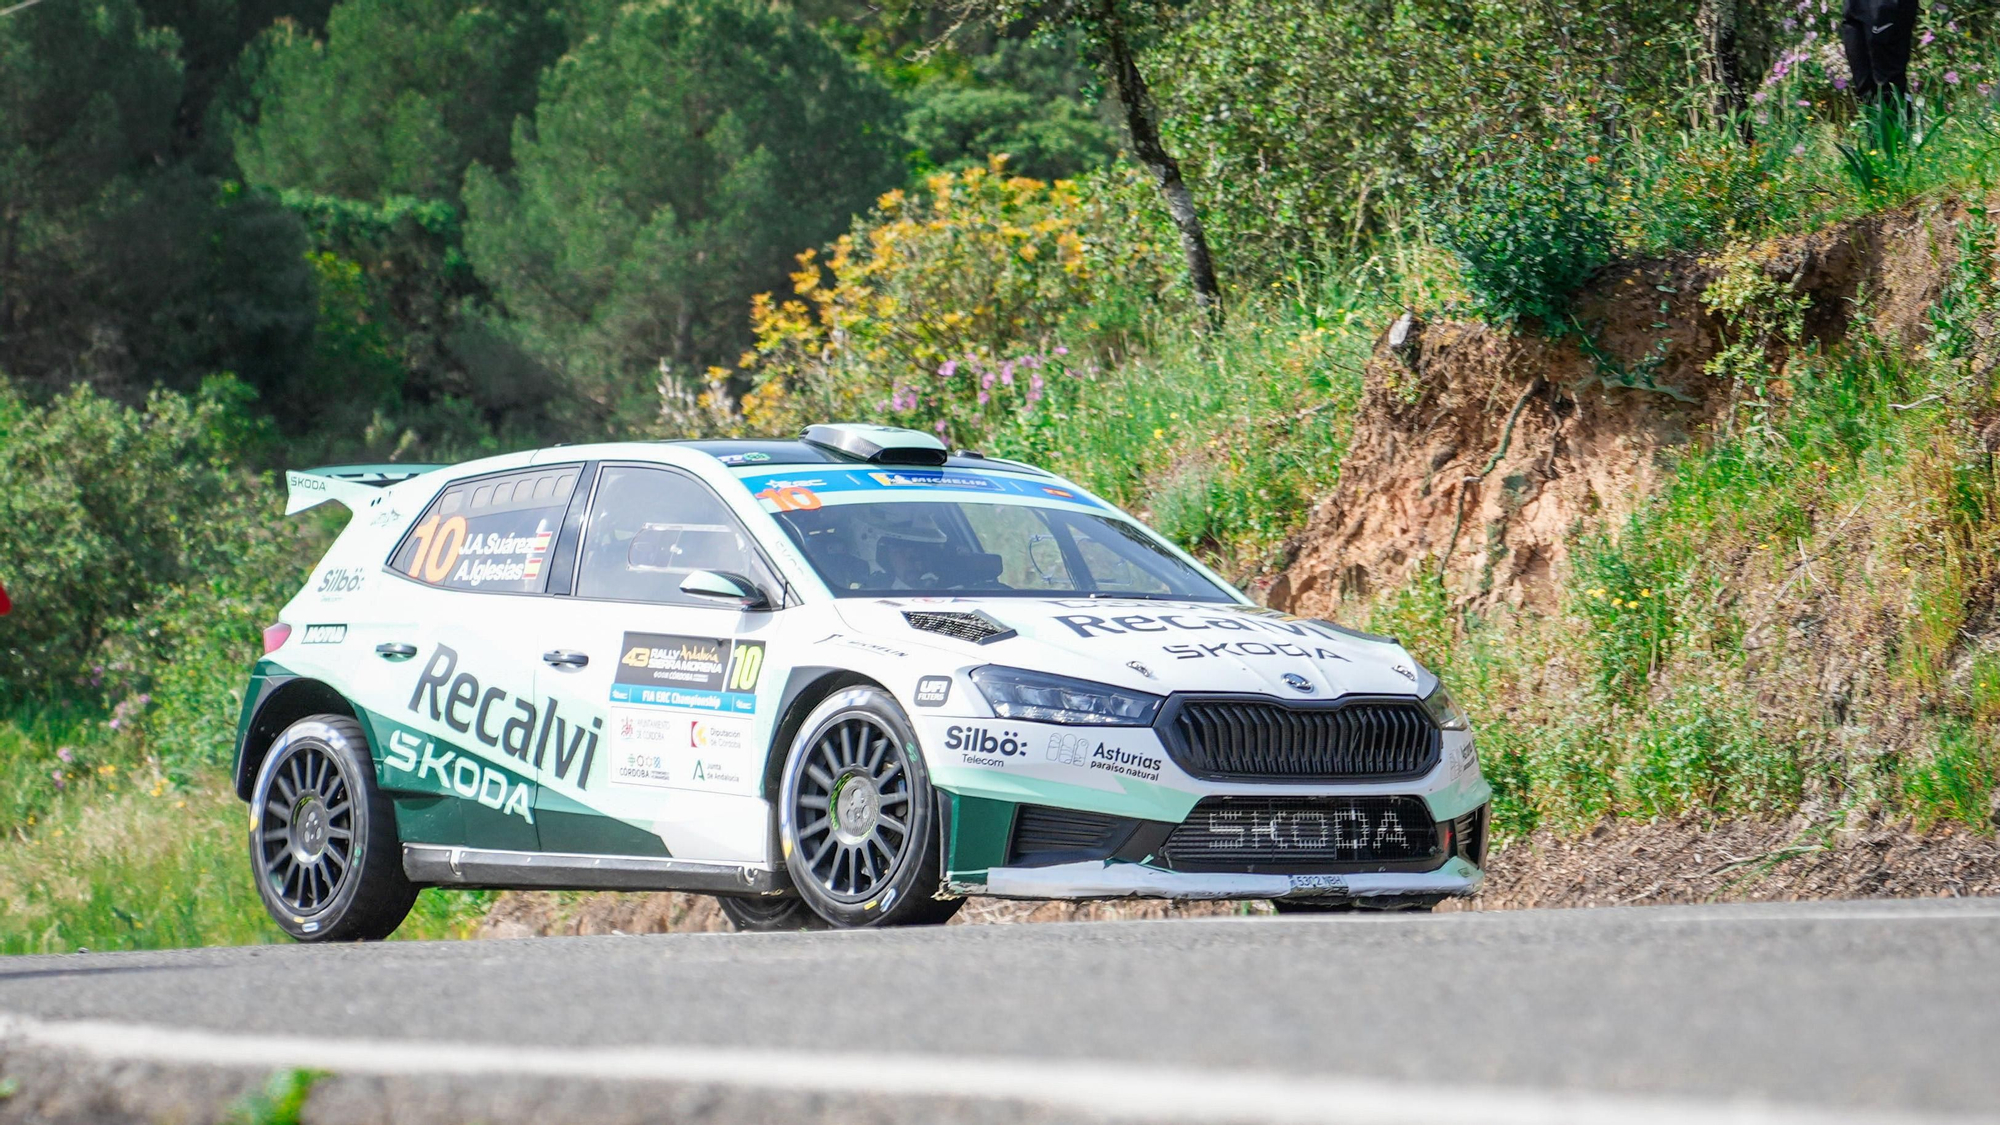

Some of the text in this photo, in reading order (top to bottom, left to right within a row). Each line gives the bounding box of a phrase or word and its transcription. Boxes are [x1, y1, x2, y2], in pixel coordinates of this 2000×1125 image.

[910, 476, 988, 486] MICHELIN
[755, 487, 822, 512] 10
[408, 514, 468, 584] 10
[454, 559, 523, 586] A.Iglesias
[1054, 613, 1339, 641] Recalvi
[621, 647, 650, 667] 43
[649, 648, 681, 660] RALLY
[1162, 642, 1352, 663] SKODA
[730, 644, 763, 690] 10
[919, 680, 948, 692] UFI
[642, 690, 655, 702] FIA
[671, 692, 721, 709] Championship
[408, 642, 603, 792] Recalvi
[962, 753, 1004, 768] Telecom
[1092, 742, 1162, 771] Asturias
[1091, 759, 1160, 781] paraíso natural
